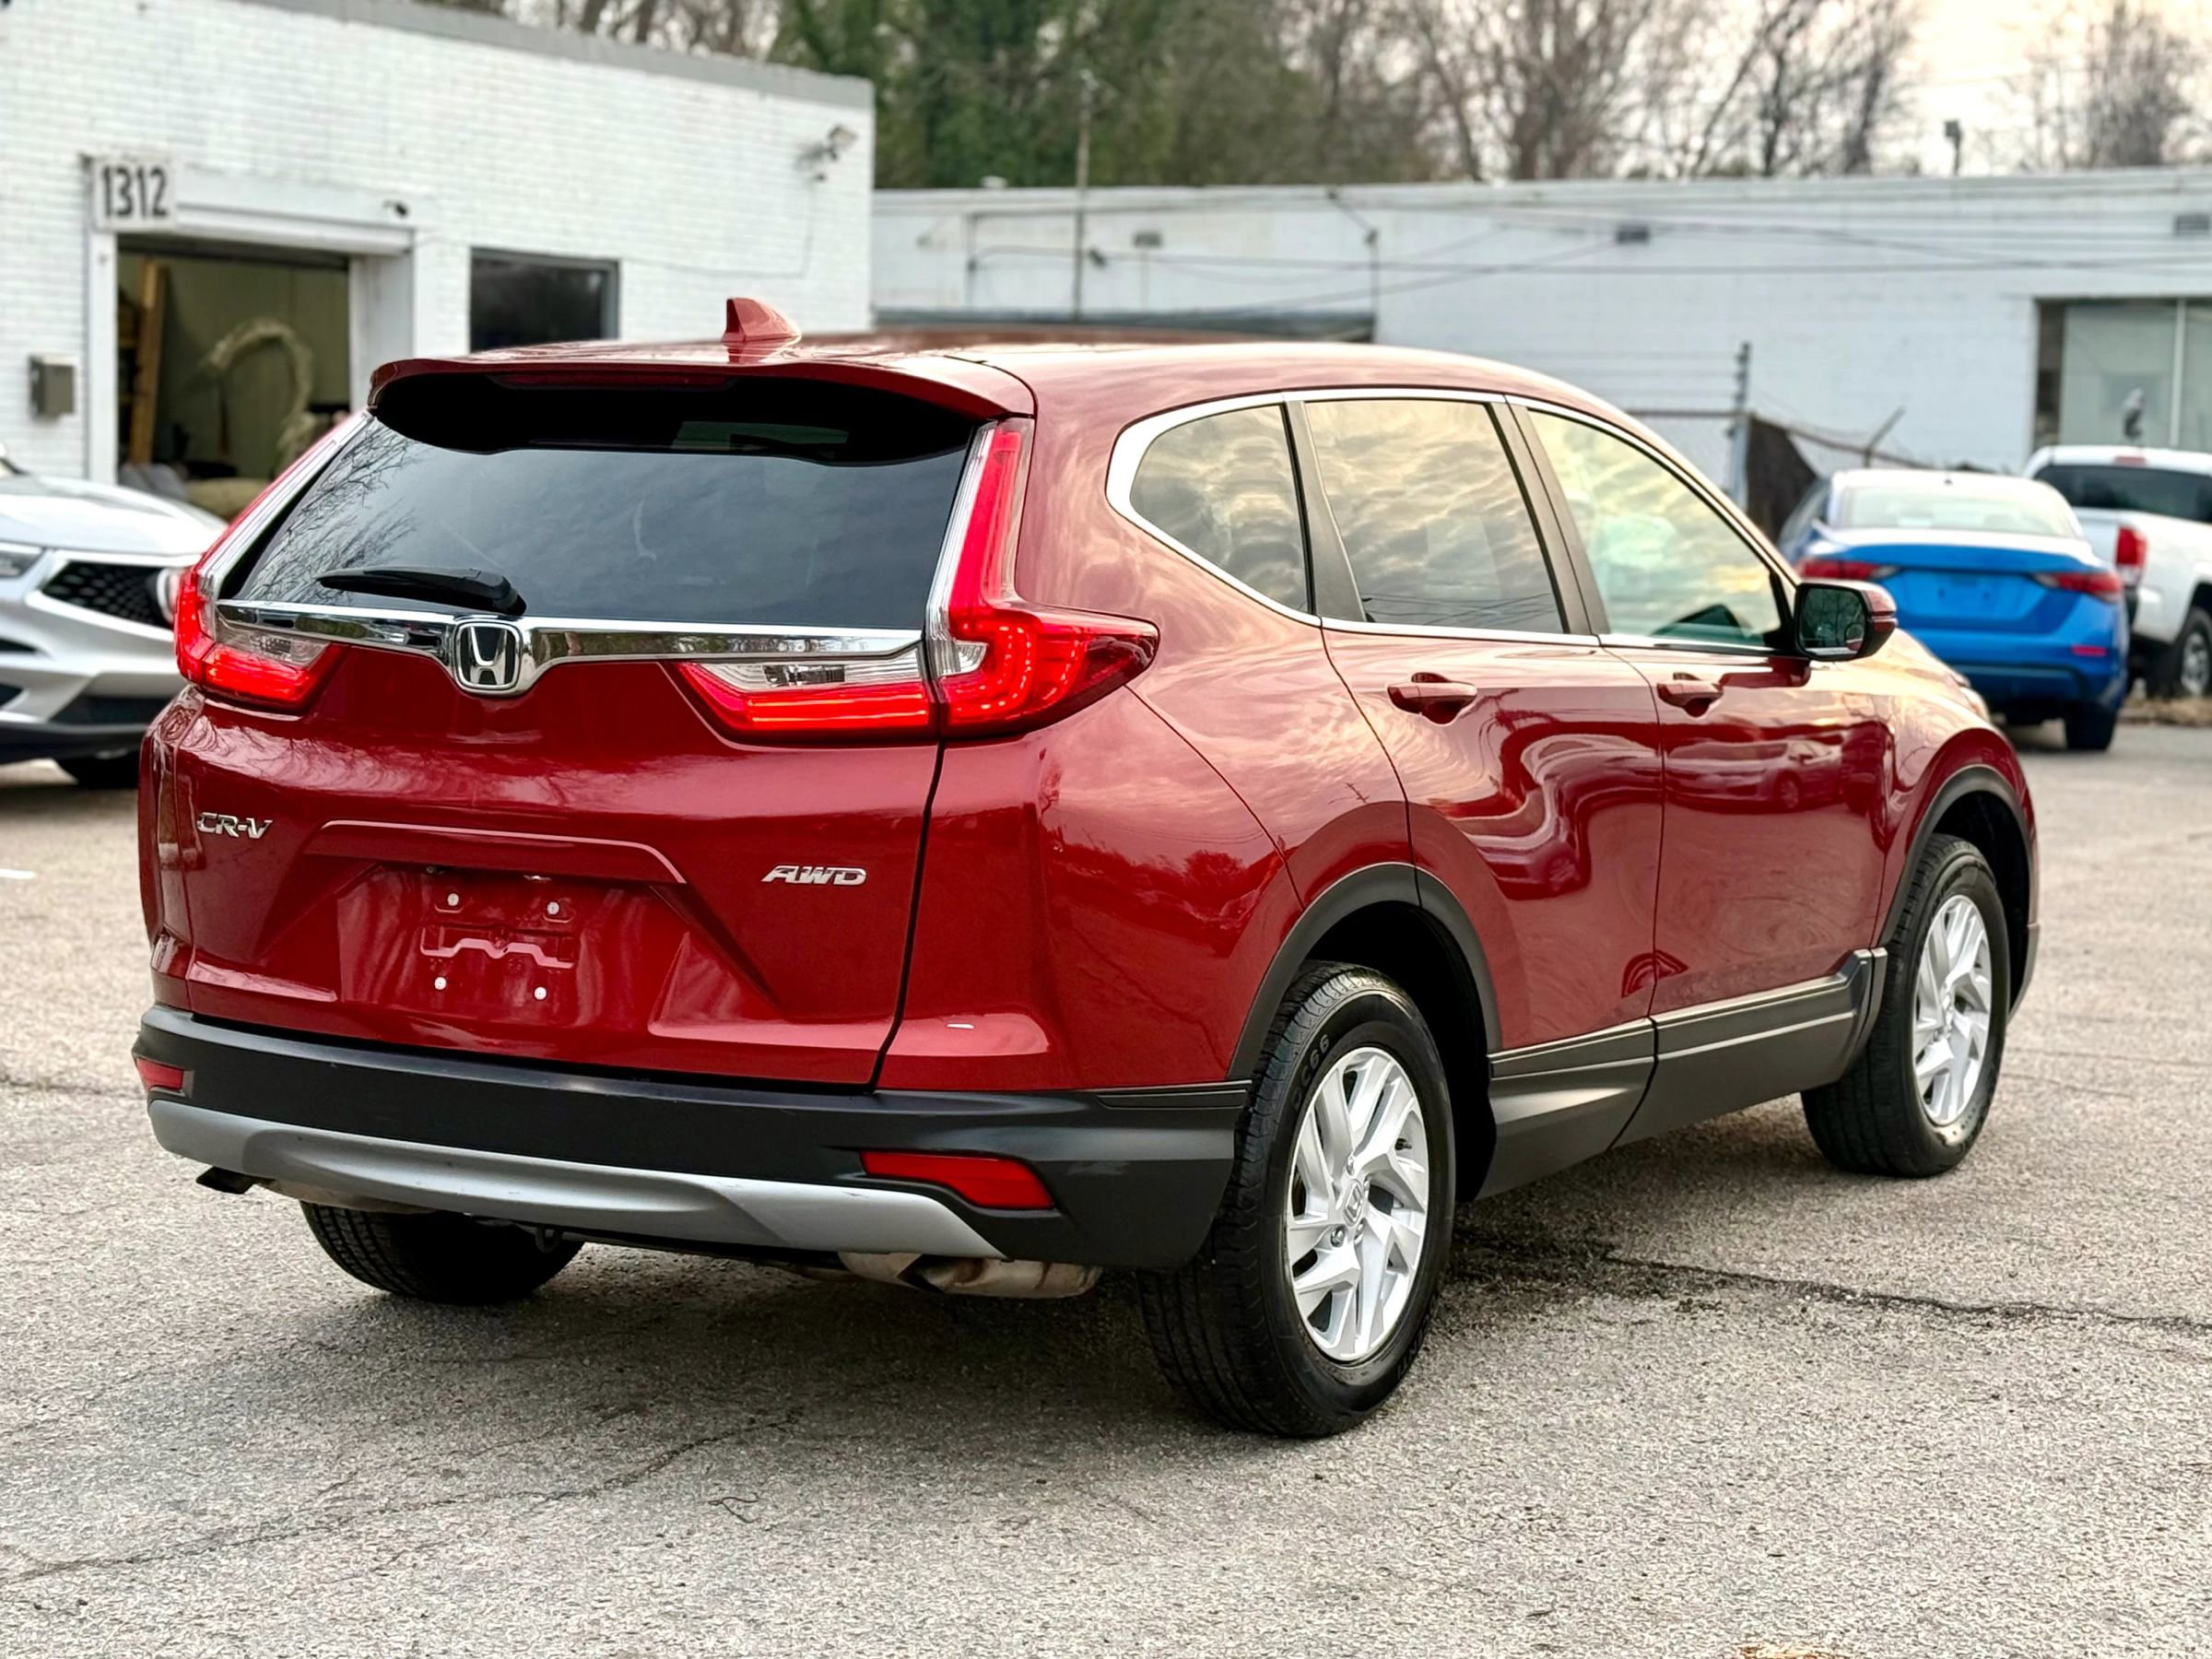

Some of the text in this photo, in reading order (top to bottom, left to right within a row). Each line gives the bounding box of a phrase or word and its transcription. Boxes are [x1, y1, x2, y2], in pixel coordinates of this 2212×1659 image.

[101, 165, 169, 218] 1312
[196, 811, 274, 840] CR-V
[760, 865, 867, 886] AWD
